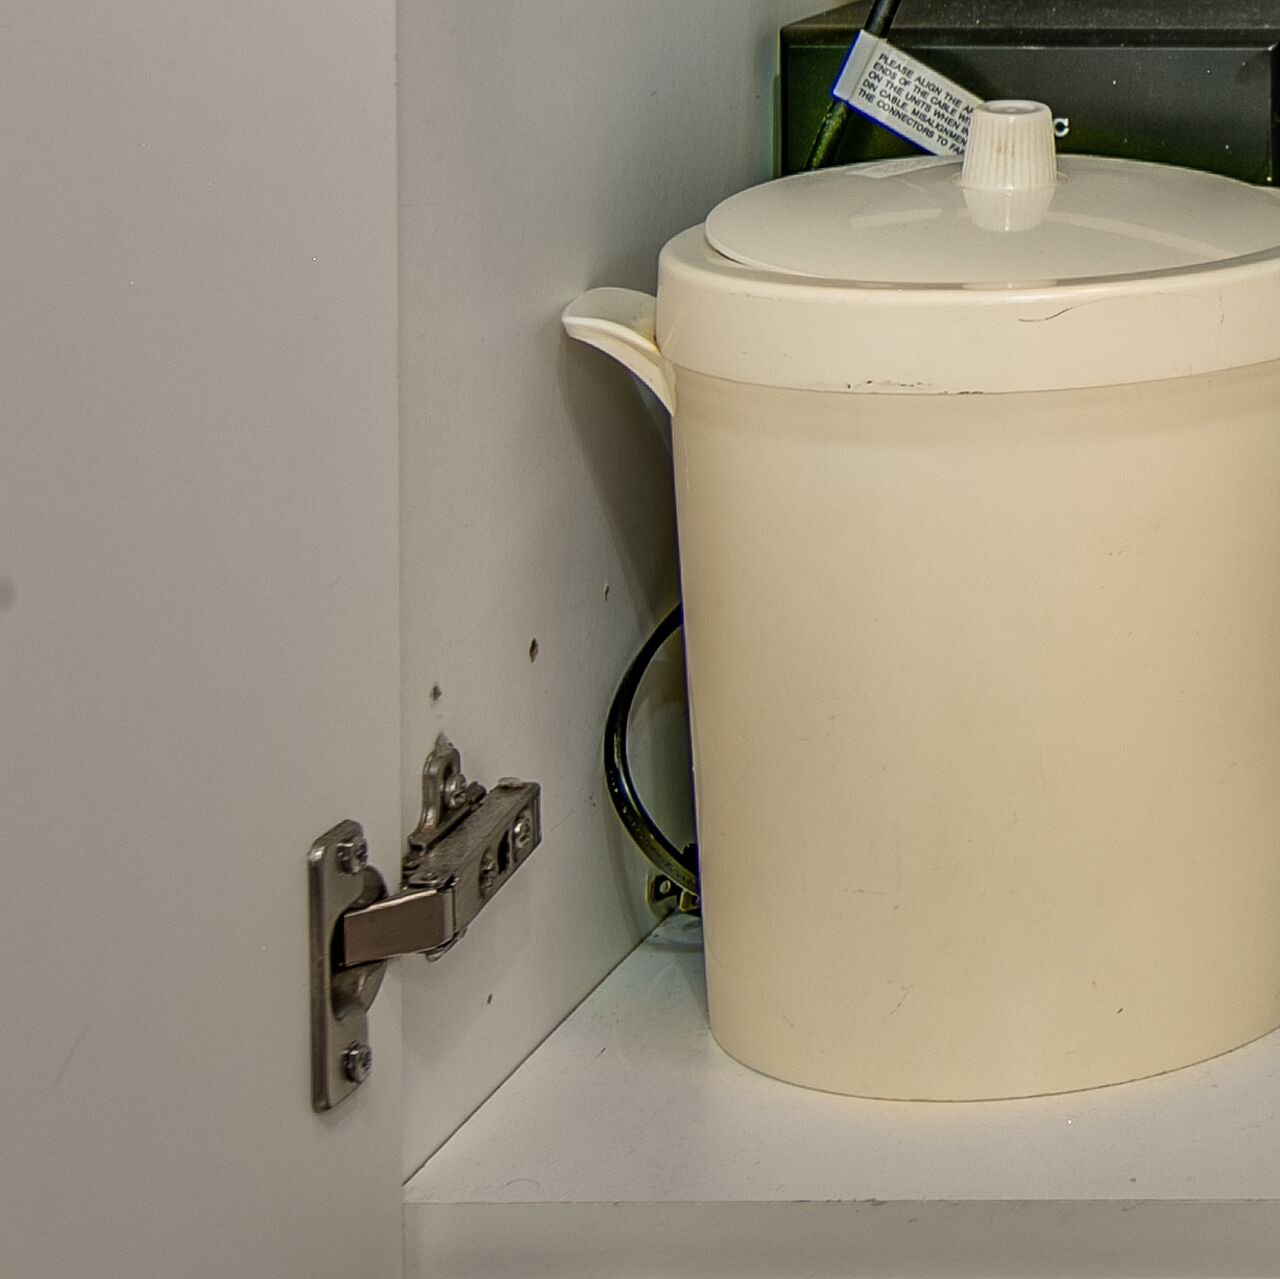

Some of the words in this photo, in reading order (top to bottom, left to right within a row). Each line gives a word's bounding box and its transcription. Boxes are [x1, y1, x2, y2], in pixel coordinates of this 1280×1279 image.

[863, 79, 878, 92] DIN
[868, 70, 883, 83] ON
[885, 80, 904, 96] THE
[905, 92, 932, 113] UNITS
[933, 110, 960, 130] WHEN
[874, 62, 898, 81] ENDS
[899, 77, 911, 89] OF
[913, 85, 929, 99] THE
[931, 96, 957, 116] CABLE
[879, 53, 914, 78] PLEASE
[916, 75, 943, 96] ALIGN
[945, 93, 962, 107] THE
[858, 88, 876, 103] THE
[877, 99, 935, 139] CONNECTORS
[937, 135, 949, 147] TO
